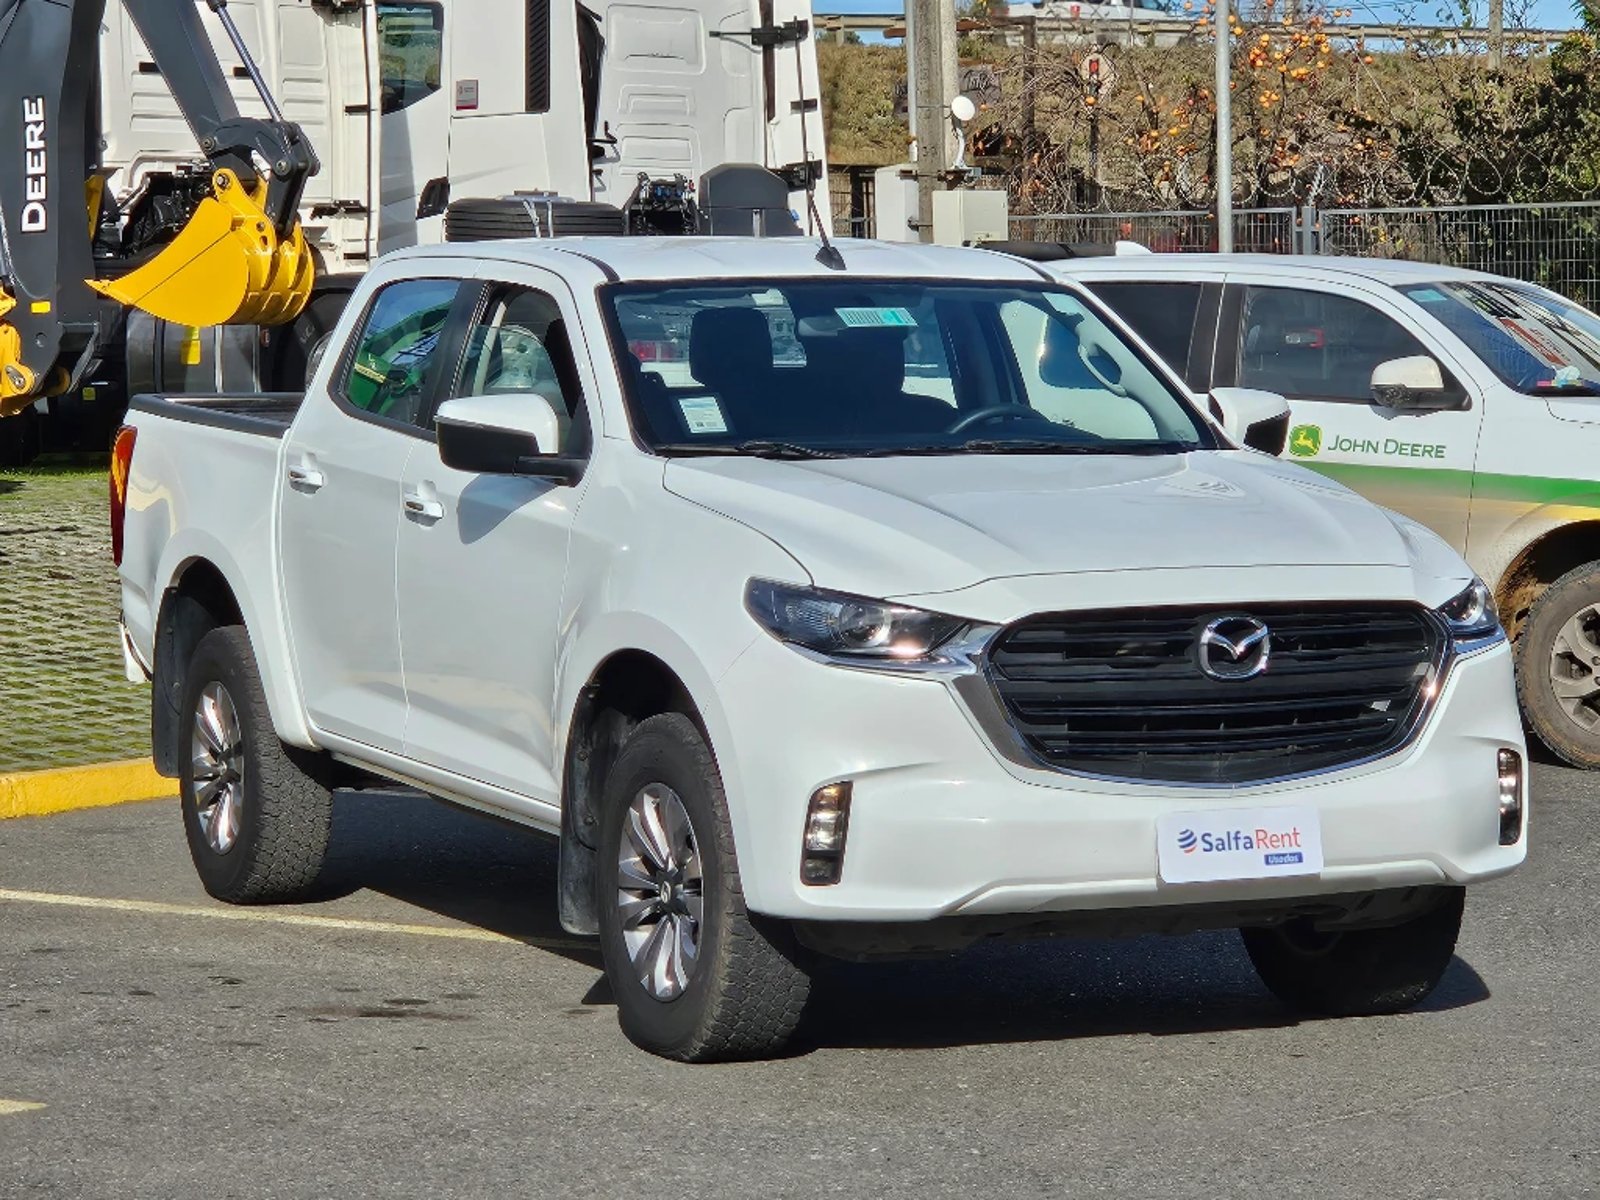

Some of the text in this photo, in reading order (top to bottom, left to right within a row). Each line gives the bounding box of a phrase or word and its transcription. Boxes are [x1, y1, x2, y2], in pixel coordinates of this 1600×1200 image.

[21, 97, 47, 232] DEERE
[1327, 435, 1447, 459] JOHN DEERE
[1201, 827, 1302, 852] SalfaRent
